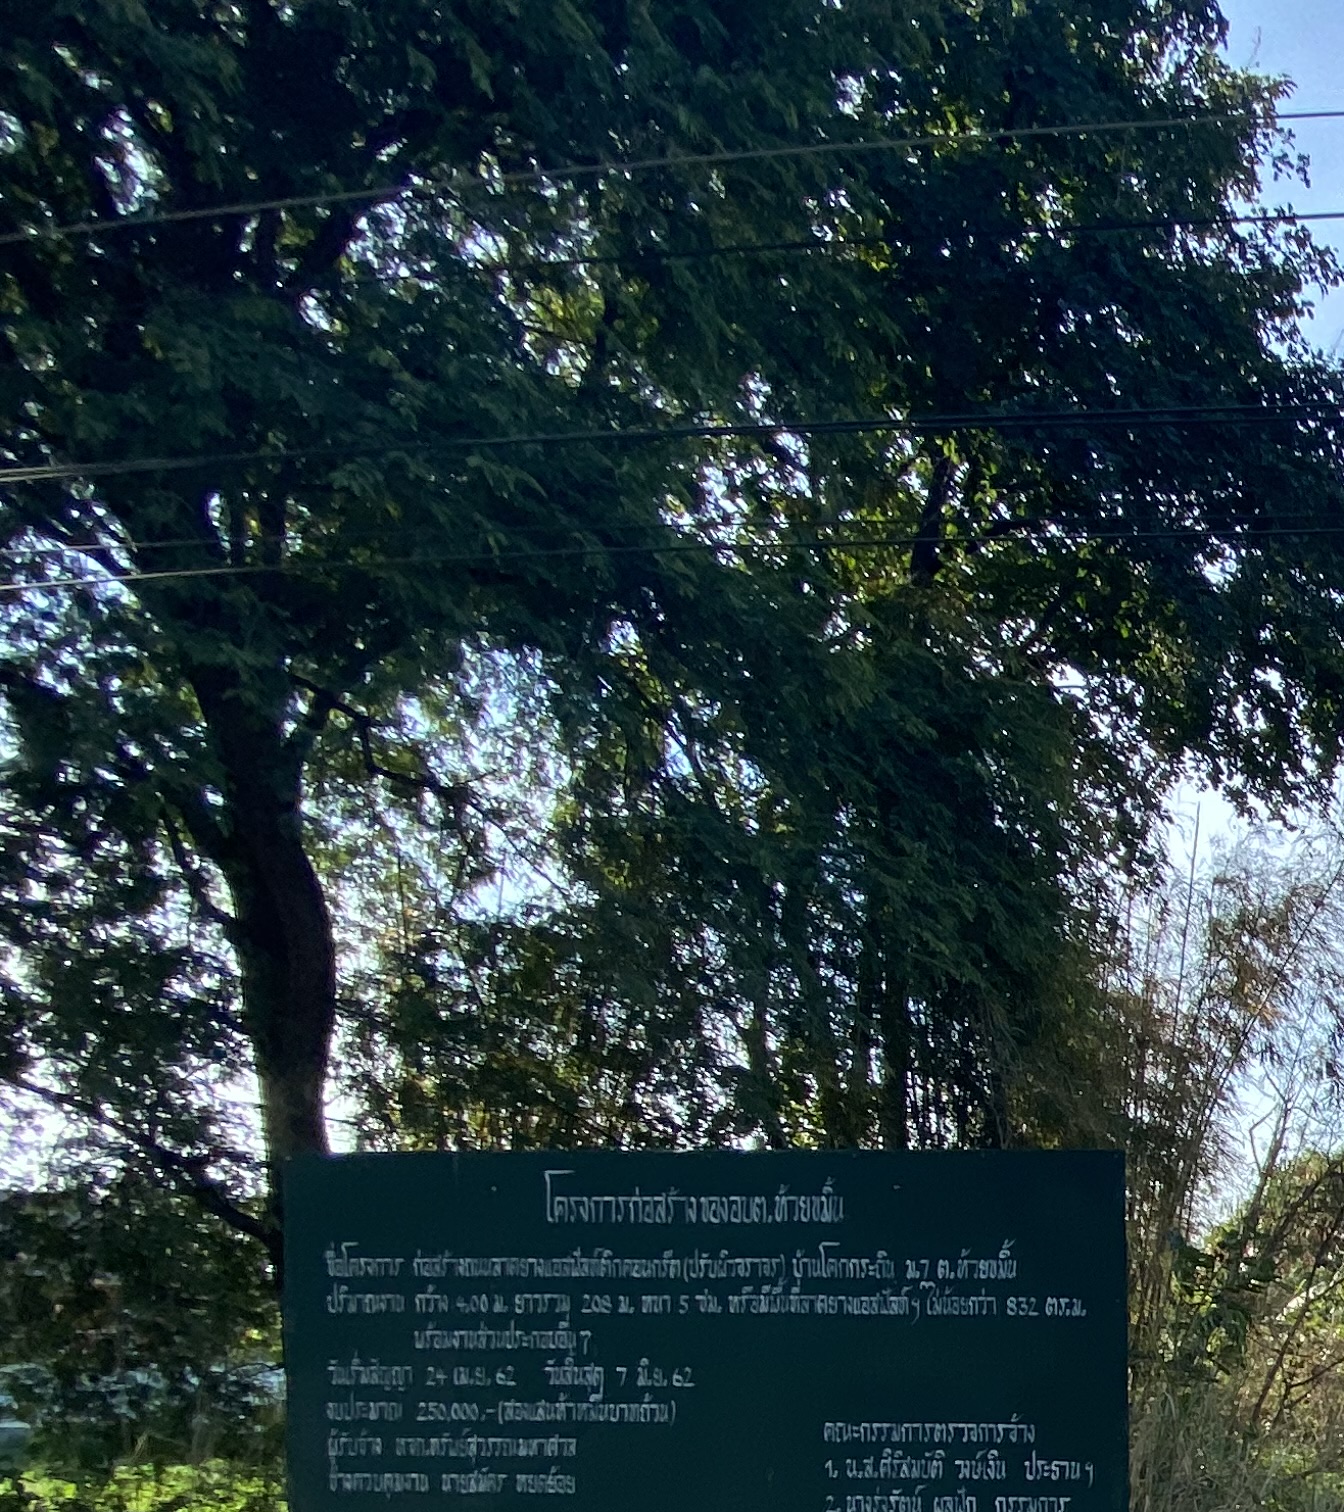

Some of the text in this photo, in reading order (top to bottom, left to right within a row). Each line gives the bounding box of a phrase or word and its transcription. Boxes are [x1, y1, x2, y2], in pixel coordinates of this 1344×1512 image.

[679, 1295, 689, 1314] 5
[1006, 1296, 1039, 1316] 832
[1045, 1297, 1087, 1317] ตร.ม.
[616, 1366, 628, 1387] 7
[672, 1366, 696, 1388] 62
